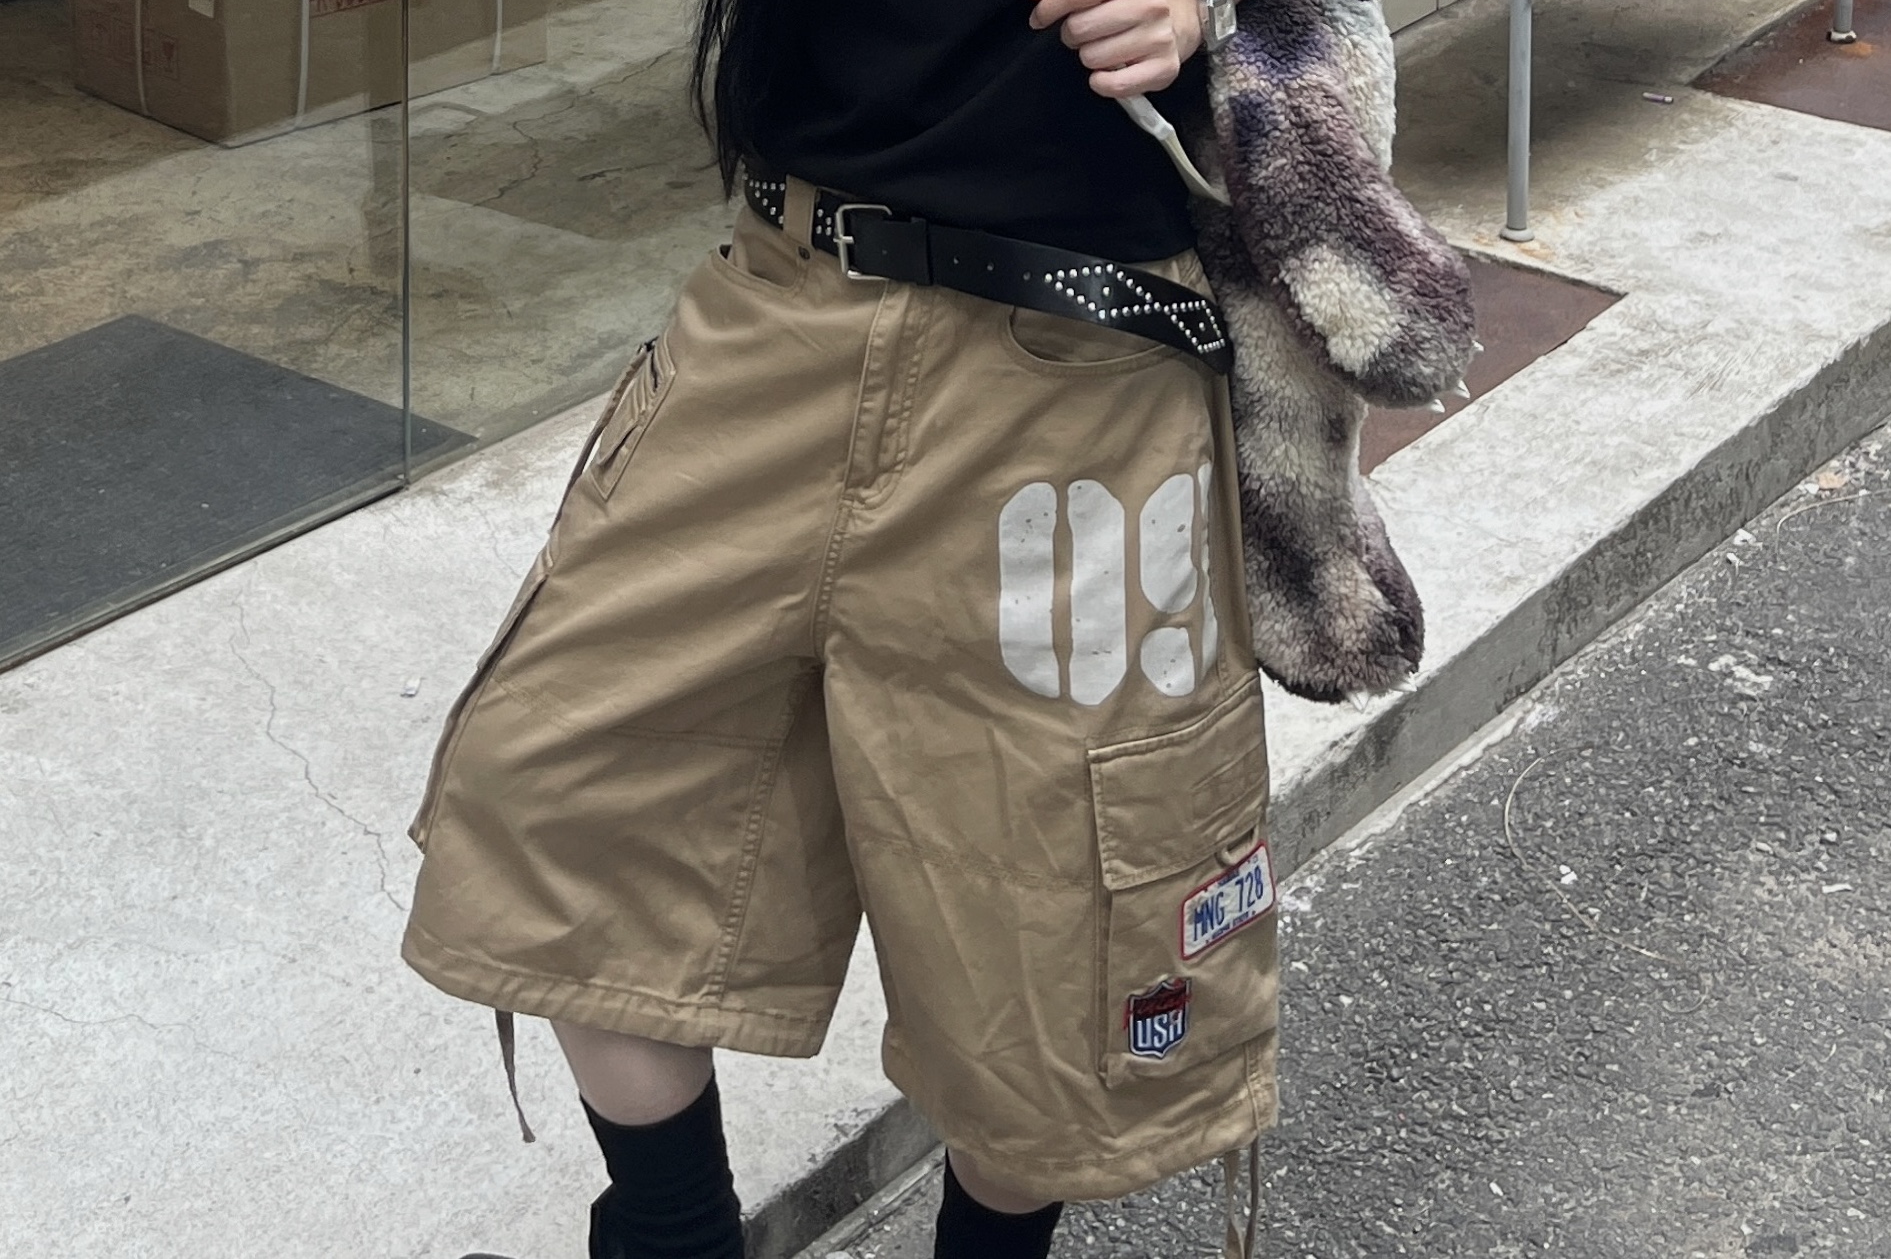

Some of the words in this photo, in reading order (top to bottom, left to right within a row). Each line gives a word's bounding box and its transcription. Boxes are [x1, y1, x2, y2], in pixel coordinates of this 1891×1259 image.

[1193, 891, 1225, 942] MNG
[1235, 865, 1264, 912] 728
[1136, 1008, 1184, 1048] USA
